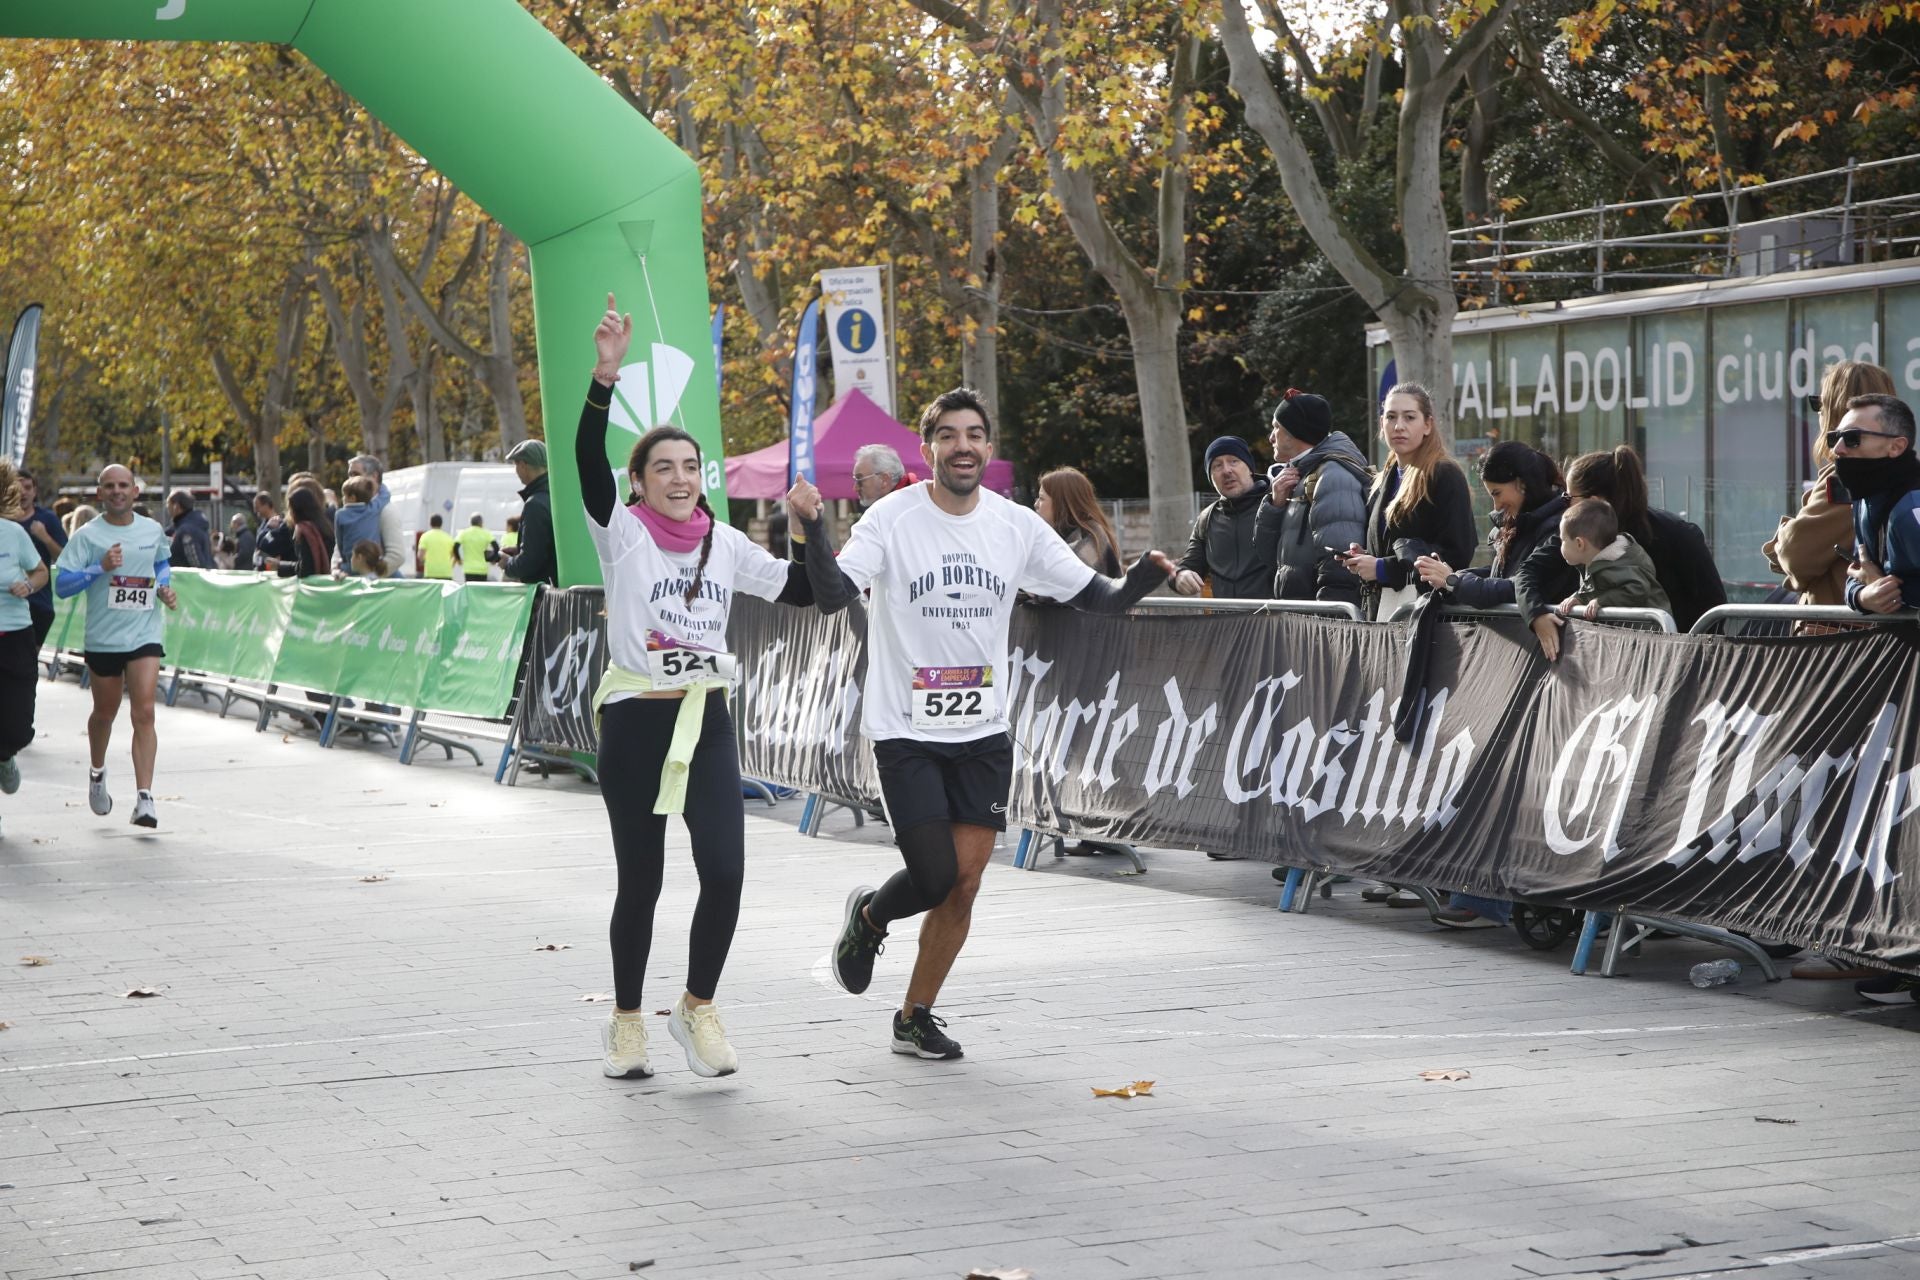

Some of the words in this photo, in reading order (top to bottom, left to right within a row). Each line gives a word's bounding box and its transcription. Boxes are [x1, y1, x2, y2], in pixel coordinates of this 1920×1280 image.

[1452, 341, 1694, 420] ALLADOLID
[942, 553, 976, 564] HOSPITAL
[115, 589, 147, 605] 849
[910, 571, 934, 603] RIO
[663, 651, 719, 676] 521
[924, 691, 982, 717] 522
[1142, 676, 1217, 800] de
[1223, 668, 1476, 832] Castilla
[1544, 694, 1657, 863] El
[1664, 699, 1920, 892] Norte
